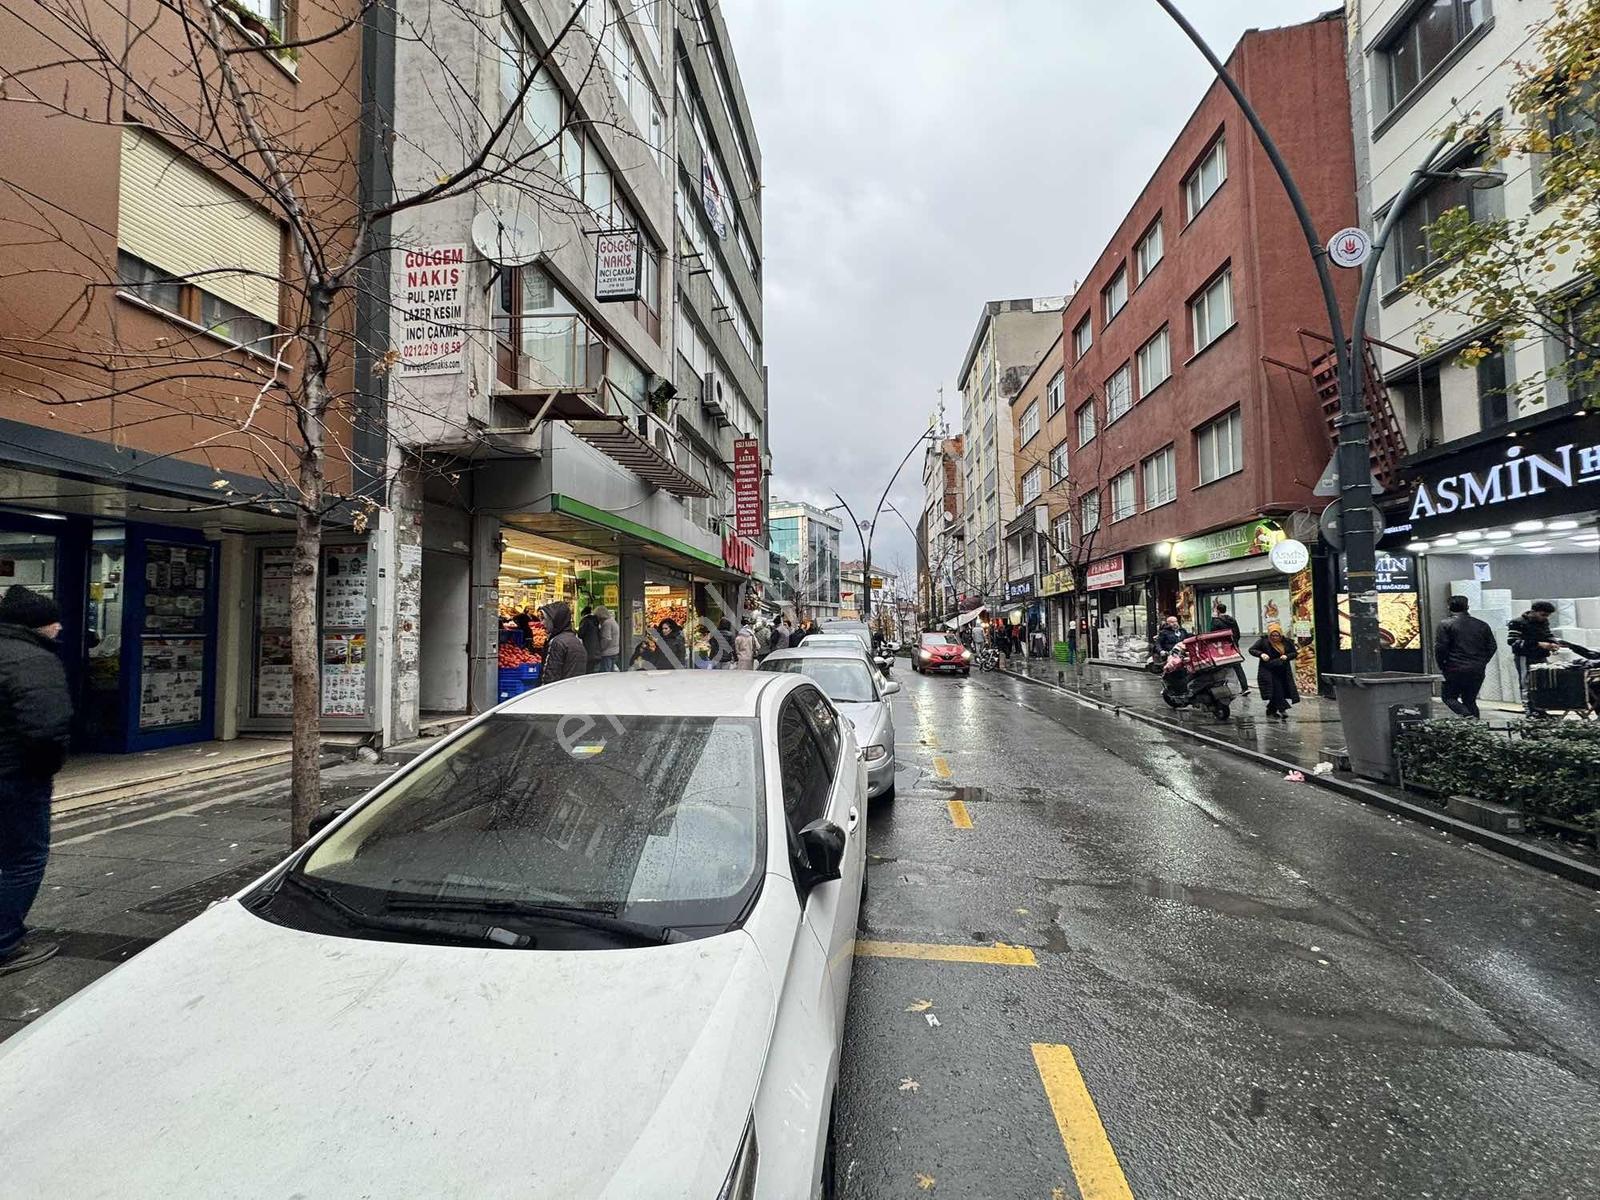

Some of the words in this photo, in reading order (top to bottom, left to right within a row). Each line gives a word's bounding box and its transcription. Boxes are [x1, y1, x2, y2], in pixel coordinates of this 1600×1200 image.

[405, 247, 463, 269] GÖLGEM
[603, 254, 632, 268] NAKIŞ
[407, 268, 459, 288] NAKIŞ
[407, 291, 426, 304] PUL
[428, 288, 458, 302] PAYET
[403, 307, 431, 322] LAZER
[433, 302, 462, 320] KESİM
[440, 341, 450, 354] 18
[1409, 444, 1574, 520] ASMİN
